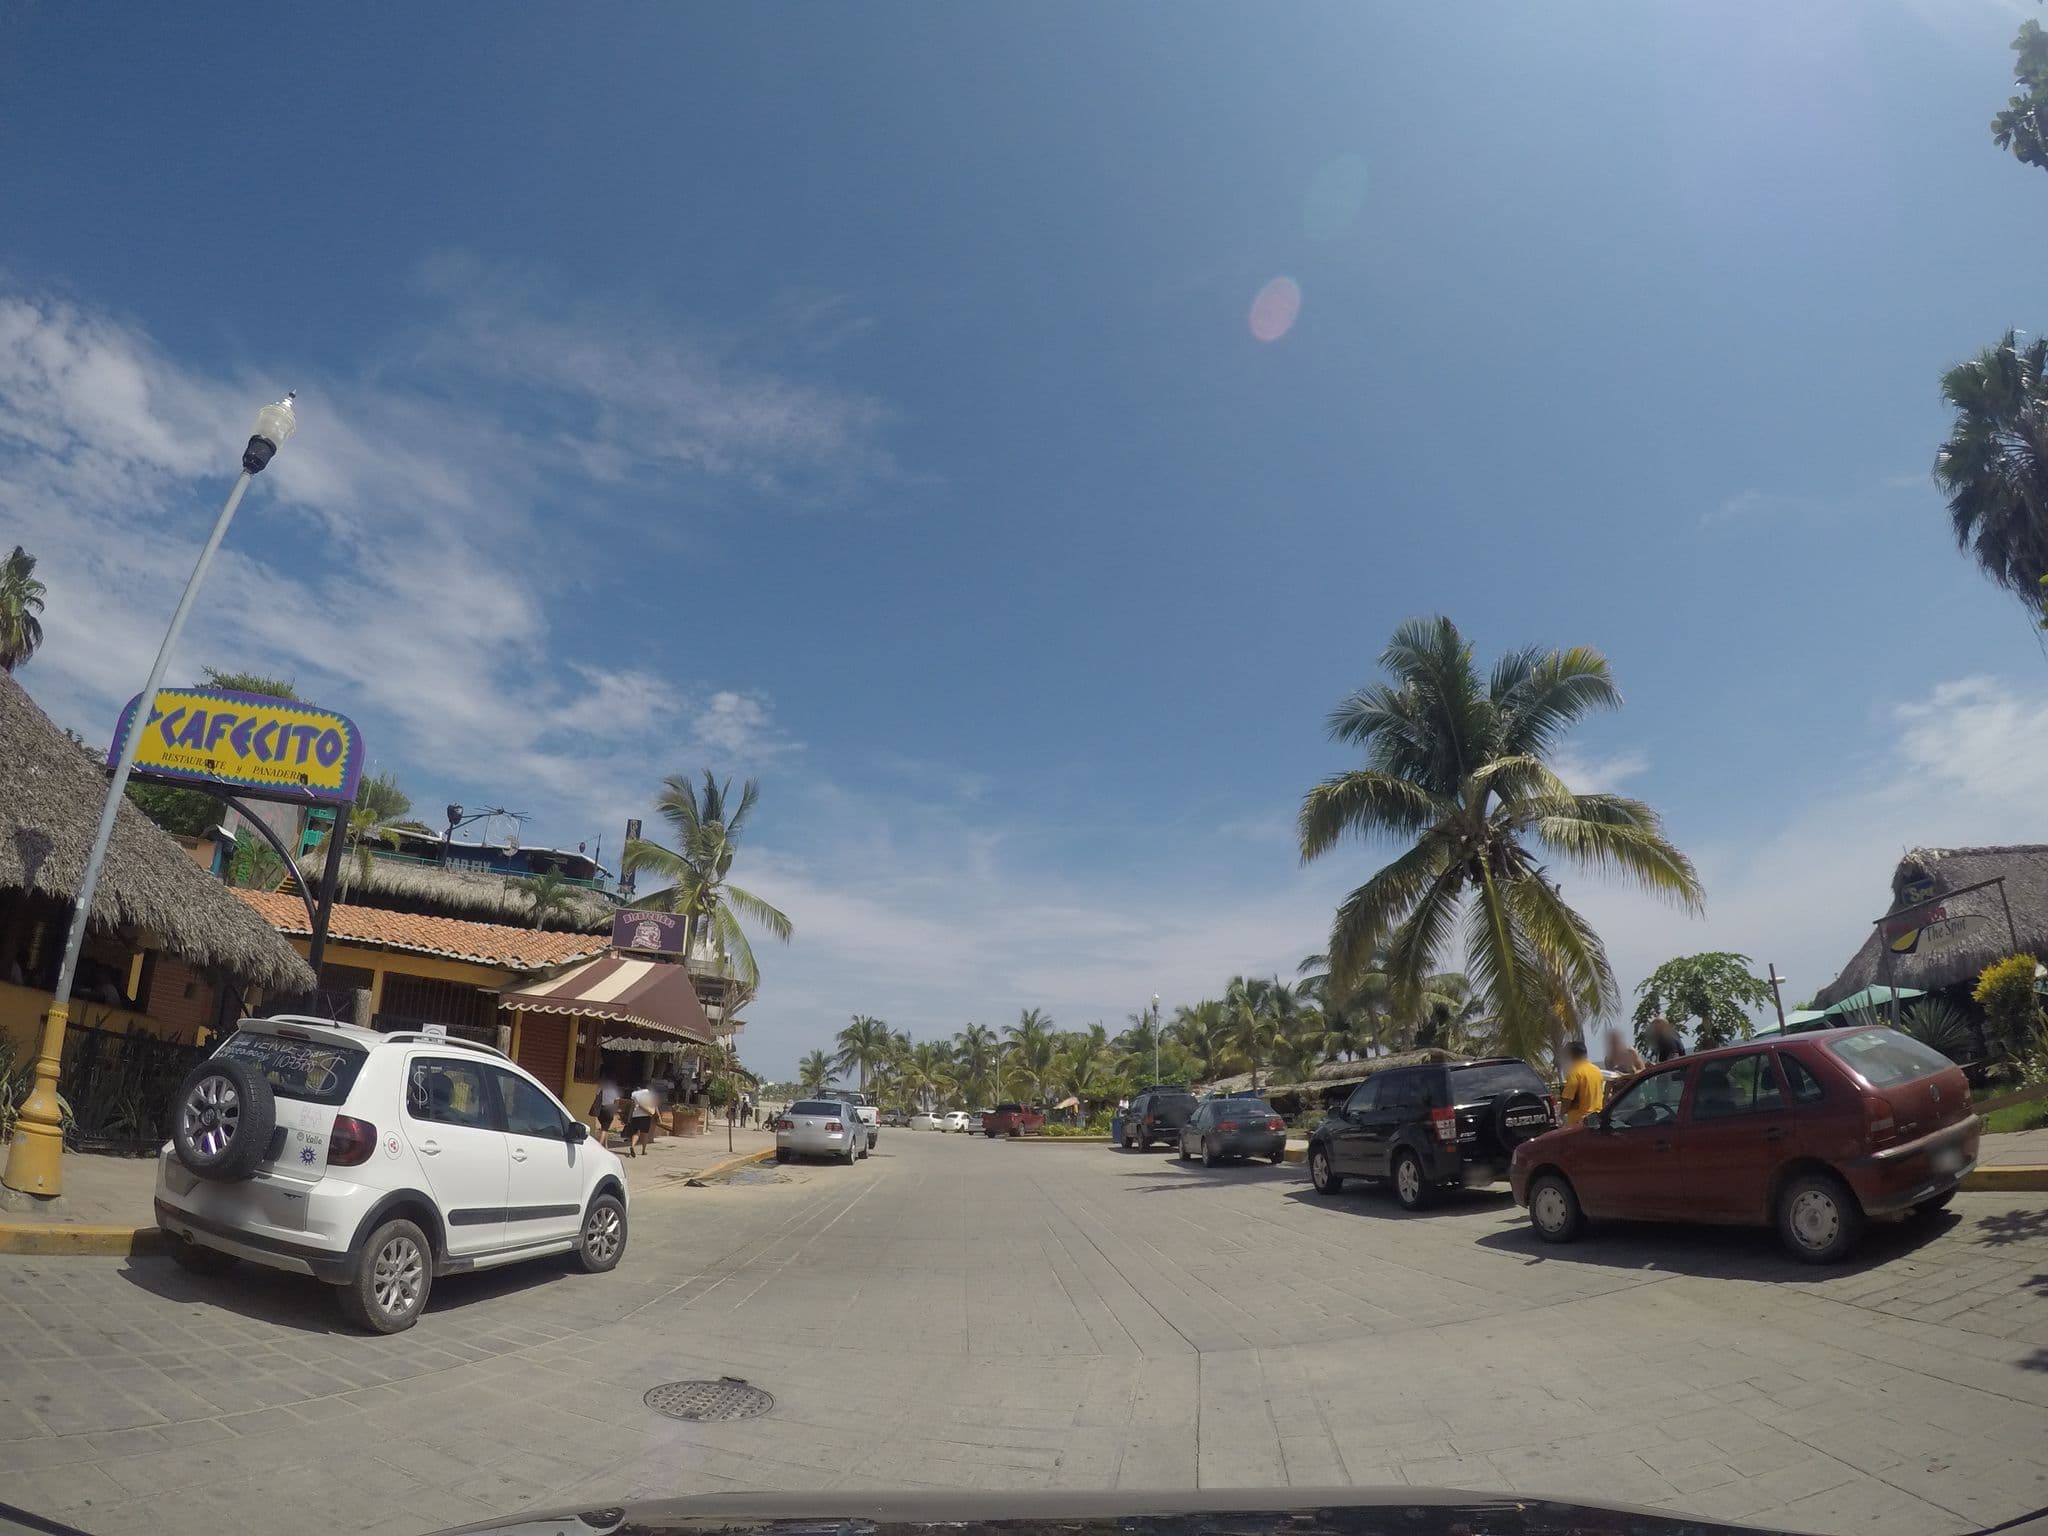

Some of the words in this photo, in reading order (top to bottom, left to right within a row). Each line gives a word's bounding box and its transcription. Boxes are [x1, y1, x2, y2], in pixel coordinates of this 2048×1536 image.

[160, 706, 344, 768] CAFECITO
[161, 752, 227, 771] RESTAURTE
[252, 766, 306, 781] PANADERI
[1927, 926, 1944, 941] The
[1945, 918, 1967, 938] Spot
[1505, 1114, 1548, 1127] SUZUKI
